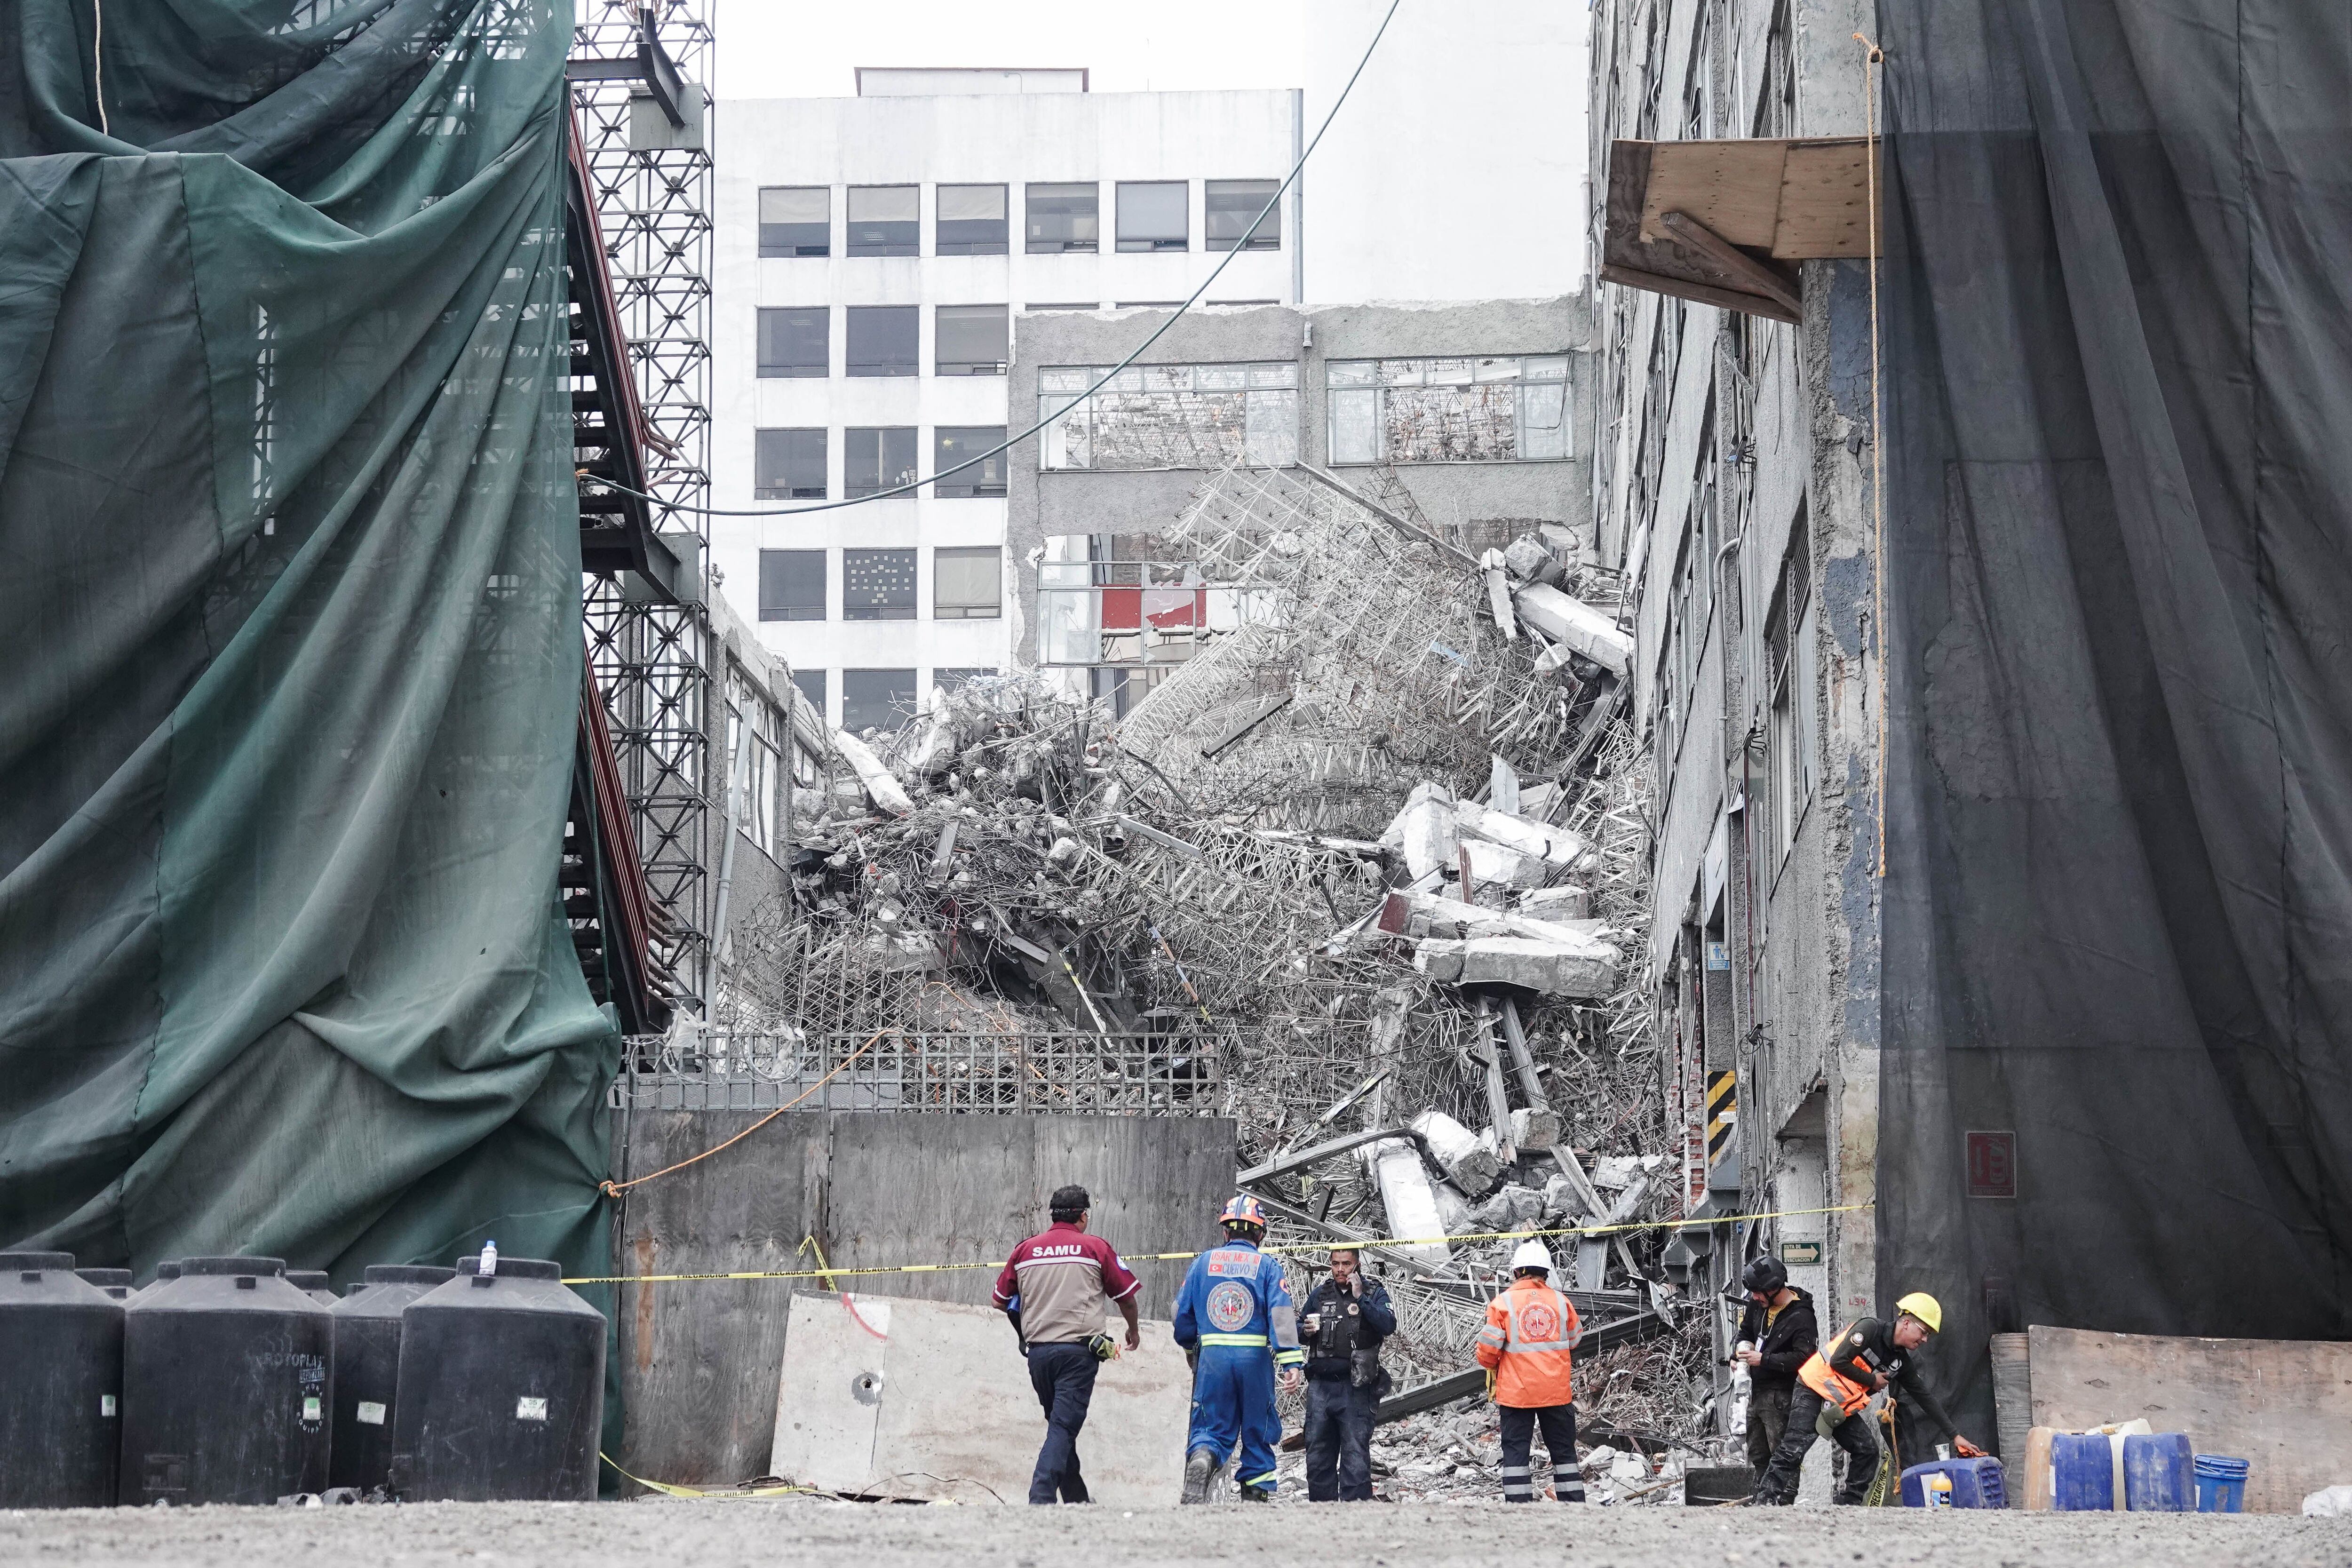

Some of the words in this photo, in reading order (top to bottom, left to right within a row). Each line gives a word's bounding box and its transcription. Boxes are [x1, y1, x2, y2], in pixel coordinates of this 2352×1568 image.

[1032, 1244, 1082, 1257] SAMU
[1211, 1252, 1231, 1261] USAR
[1233, 1252, 1250, 1262] MEX
[1223, 1263, 1250, 1275] CUERVO
